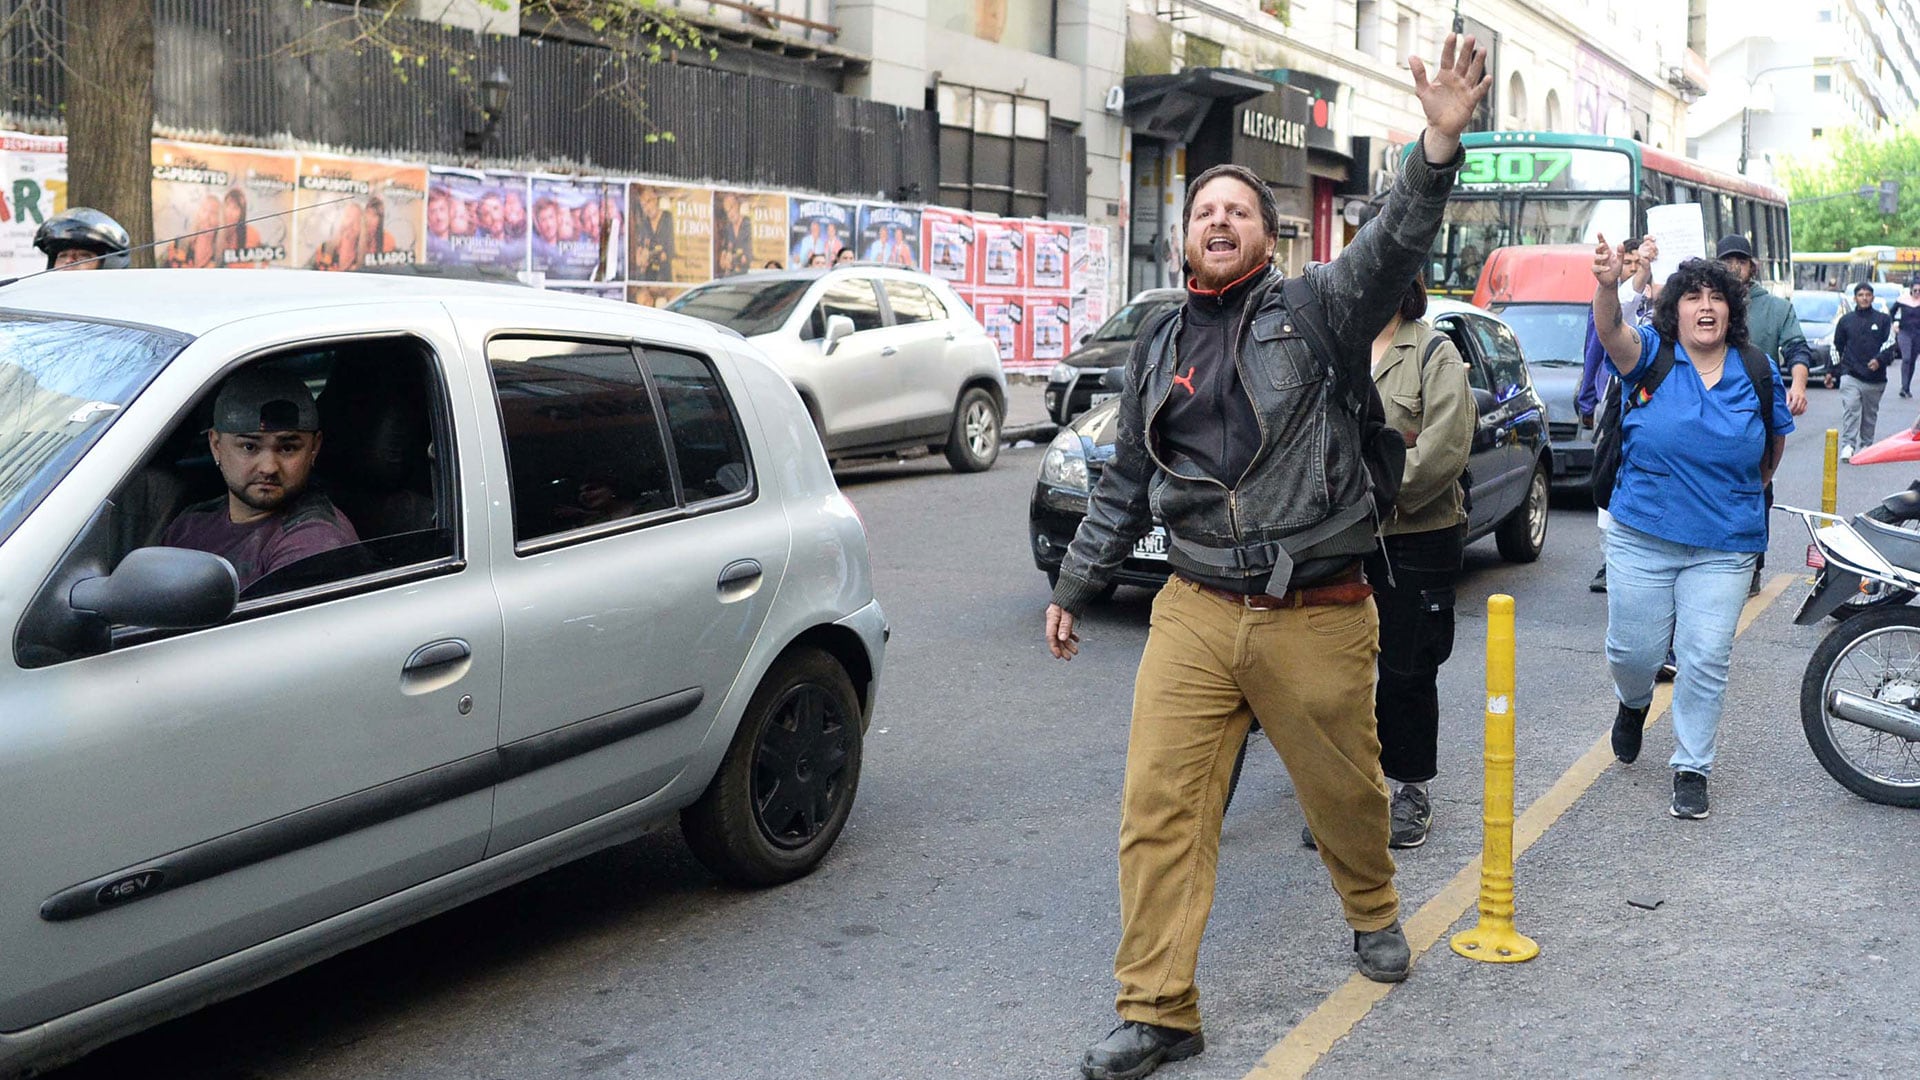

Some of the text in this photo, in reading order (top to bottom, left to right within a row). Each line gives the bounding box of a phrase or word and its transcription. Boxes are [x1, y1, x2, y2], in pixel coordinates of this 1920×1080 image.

[1243, 108, 1306, 149] ALFISJEANS
[152, 165, 227, 185] CAPUSOTTO
[1461, 151, 1572, 183] 307
[303, 176, 368, 194] CAPUSOTTO
[0, 178, 68, 224] RT
[224, 249, 238, 263] EL
[239, 248, 273, 262] LADO
[365, 253, 378, 266] EL
[378, 252, 405, 265] LADO
